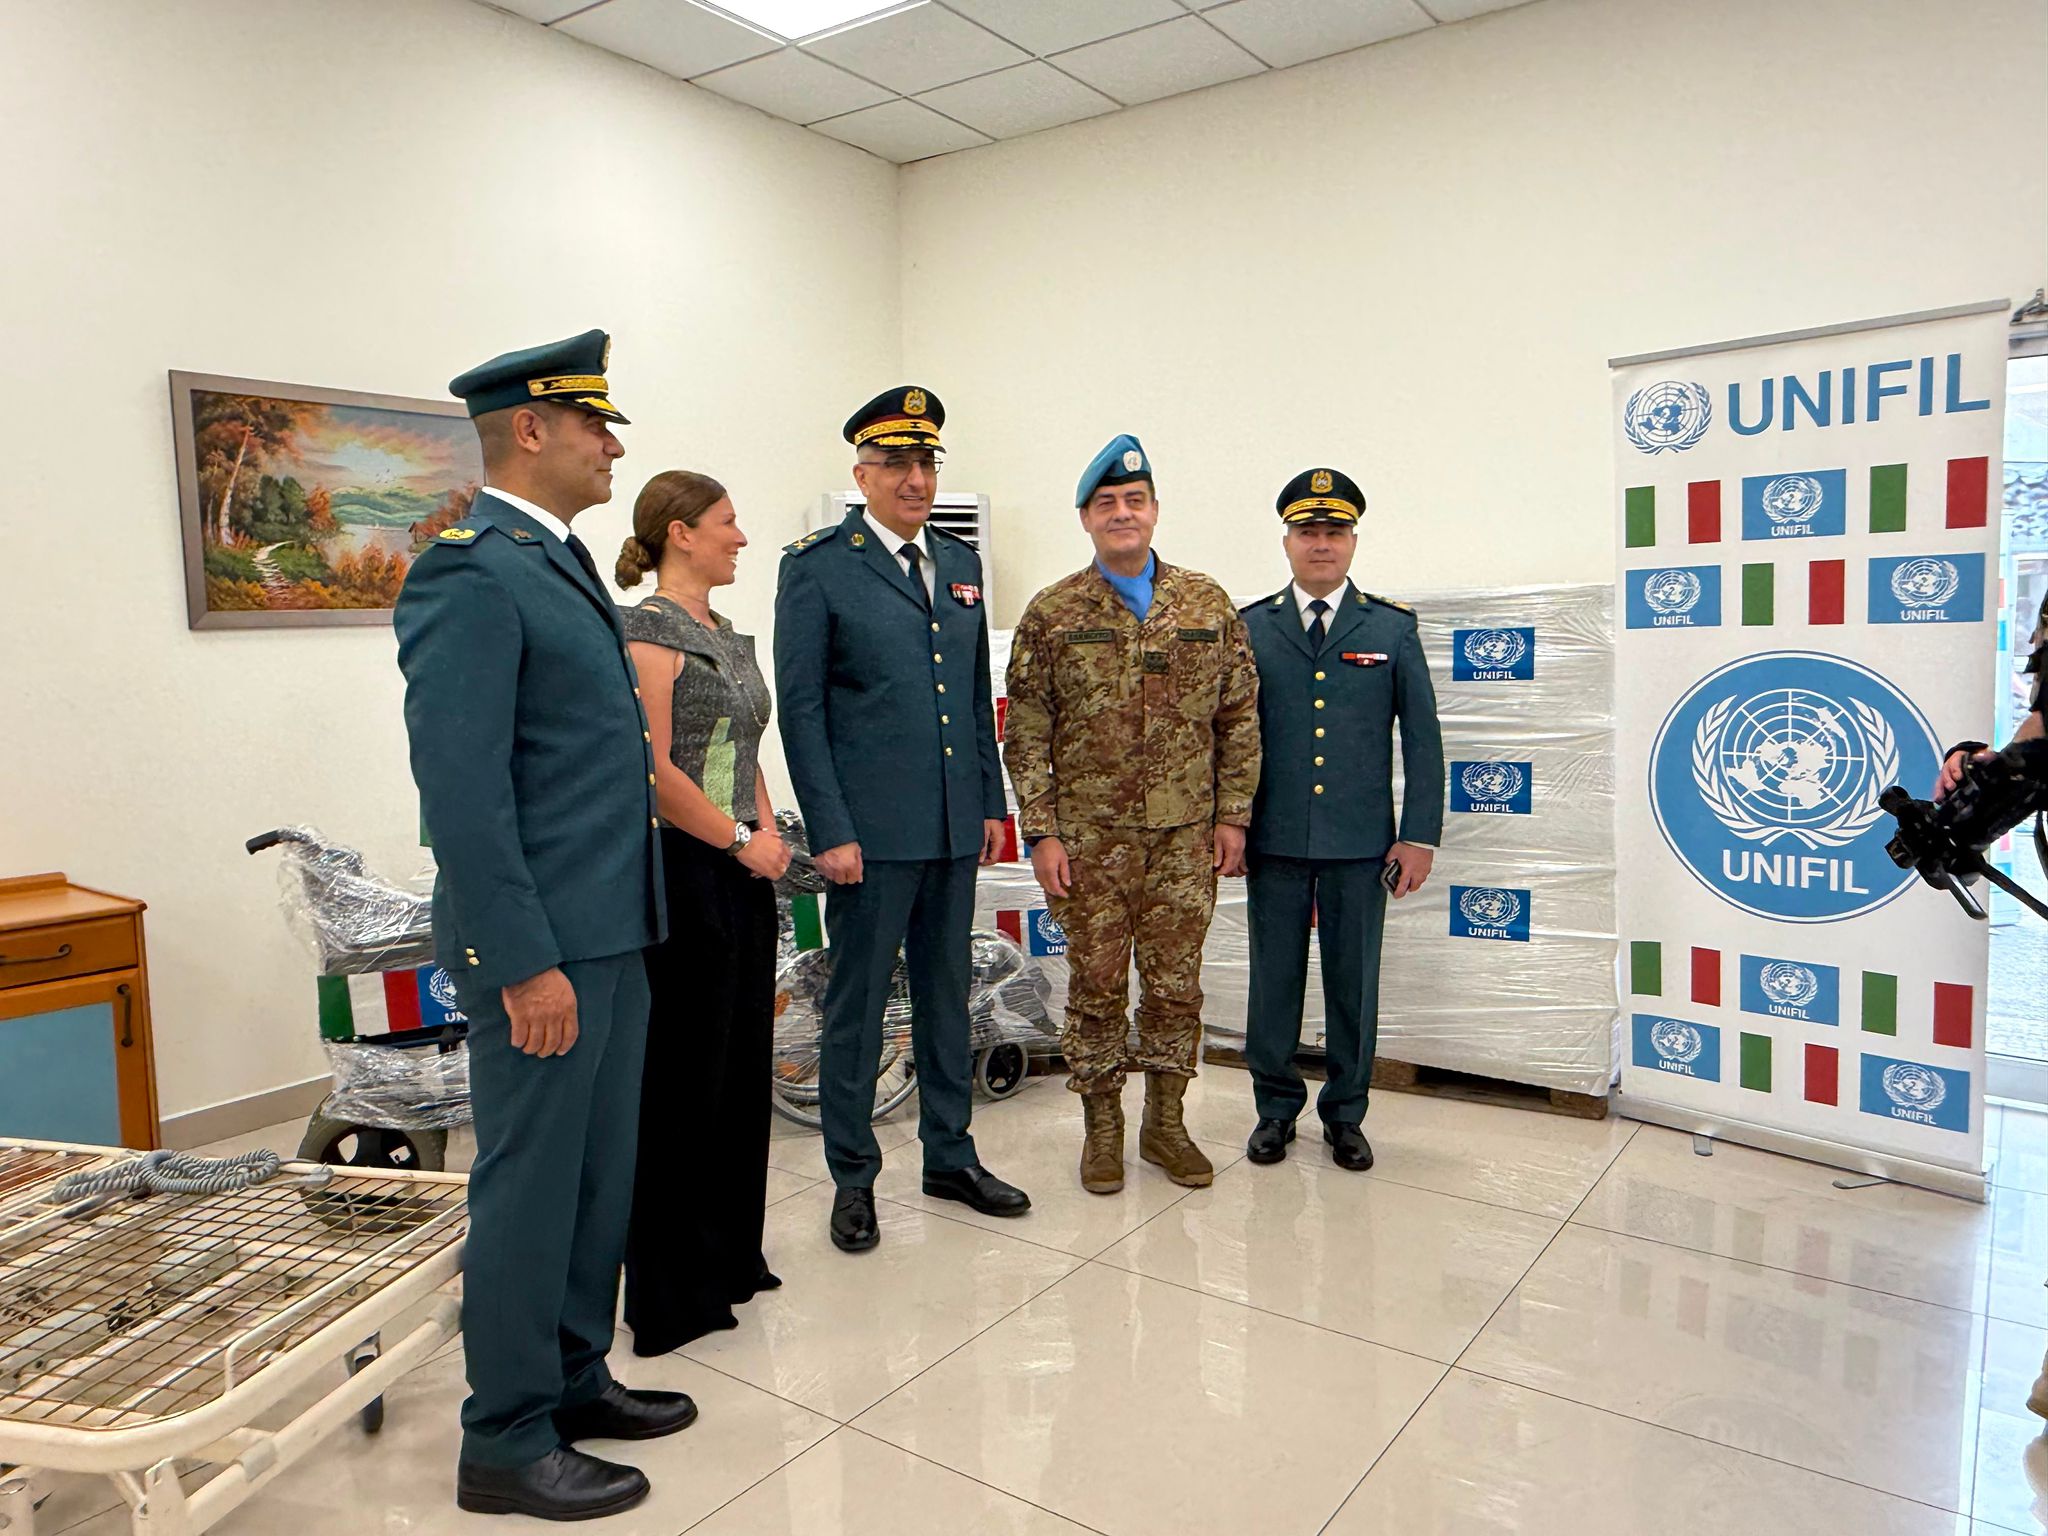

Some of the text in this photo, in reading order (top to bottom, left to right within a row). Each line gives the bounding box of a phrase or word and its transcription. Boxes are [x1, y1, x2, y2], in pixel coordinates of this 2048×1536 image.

[1728, 353, 1990, 435] UNIFIL
[1771, 524, 1814, 537] UNIFIL
[1653, 615, 1694, 626] UNIFIL
[1900, 609, 1949, 621] UNIFIL
[1473, 670, 1516, 680] UNIFIL
[1471, 802, 1514, 813] UNIFIL
[1722, 849, 1869, 894] UNIFIL
[1468, 927, 1511, 938] UNIFIL
[1769, 1004, 1810, 1019] UNIFIL
[1659, 1059, 1695, 1075] UNIFIL
[1892, 1106, 1937, 1125] UNIFIL
